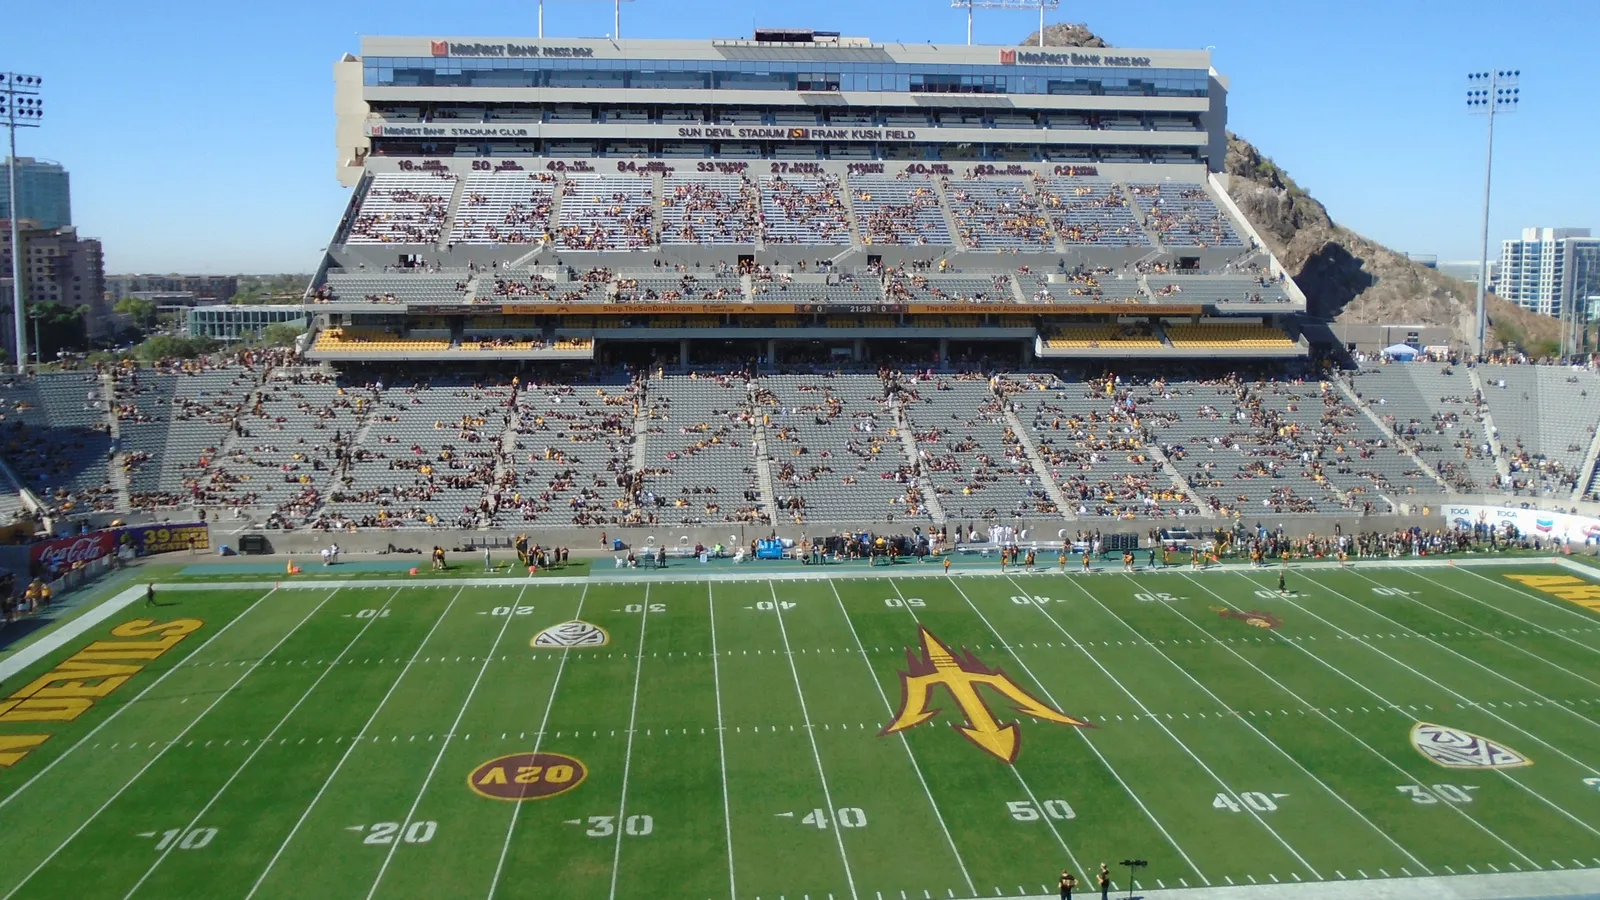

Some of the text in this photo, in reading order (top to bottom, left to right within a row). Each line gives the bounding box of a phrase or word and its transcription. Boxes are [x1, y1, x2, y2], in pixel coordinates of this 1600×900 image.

[678, 128, 700, 137] SUN
[705, 128, 735, 137] DEVIL
[738, 128, 785, 138] STADIUM
[811, 130, 848, 138] FRANK
[851, 130, 881, 138] KUSH
[885, 130, 916, 139] FIELD
[398, 160, 413, 171] 16
[472, 160, 491, 171] 50
[546, 161, 565, 171] 42
[617, 161, 636, 172] 84
[697, 162, 715, 172] 33
[771, 162, 788, 173] 27
[906, 164, 926, 174] 40
[977, 165, 995, 175] 52
[1054, 165, 1073, 176] 62
[1497, 510, 1518, 519] TOCA
[144, 528, 170, 543] 39
[144, 540, 209, 551] LOCATNS
[1011, 595, 1050, 605] 40
[1134, 592, 1181, 602] 30
[625, 603, 666, 613] 30
[757, 601, 797, 611] 40
[884, 598, 927, 608] 50
[356, 609, 391, 618] 10
[491, 605, 535, 615] 20
[0, 618, 205, 722] DEVILS
[1396, 784, 1474, 804] 30
[1212, 791, 1280, 812] 40
[1006, 799, 1077, 821] 50
[802, 807, 868, 829] 40
[585, 814, 654, 837] 30
[363, 821, 438, 845] 20
[154, 827, 219, 851] 10
